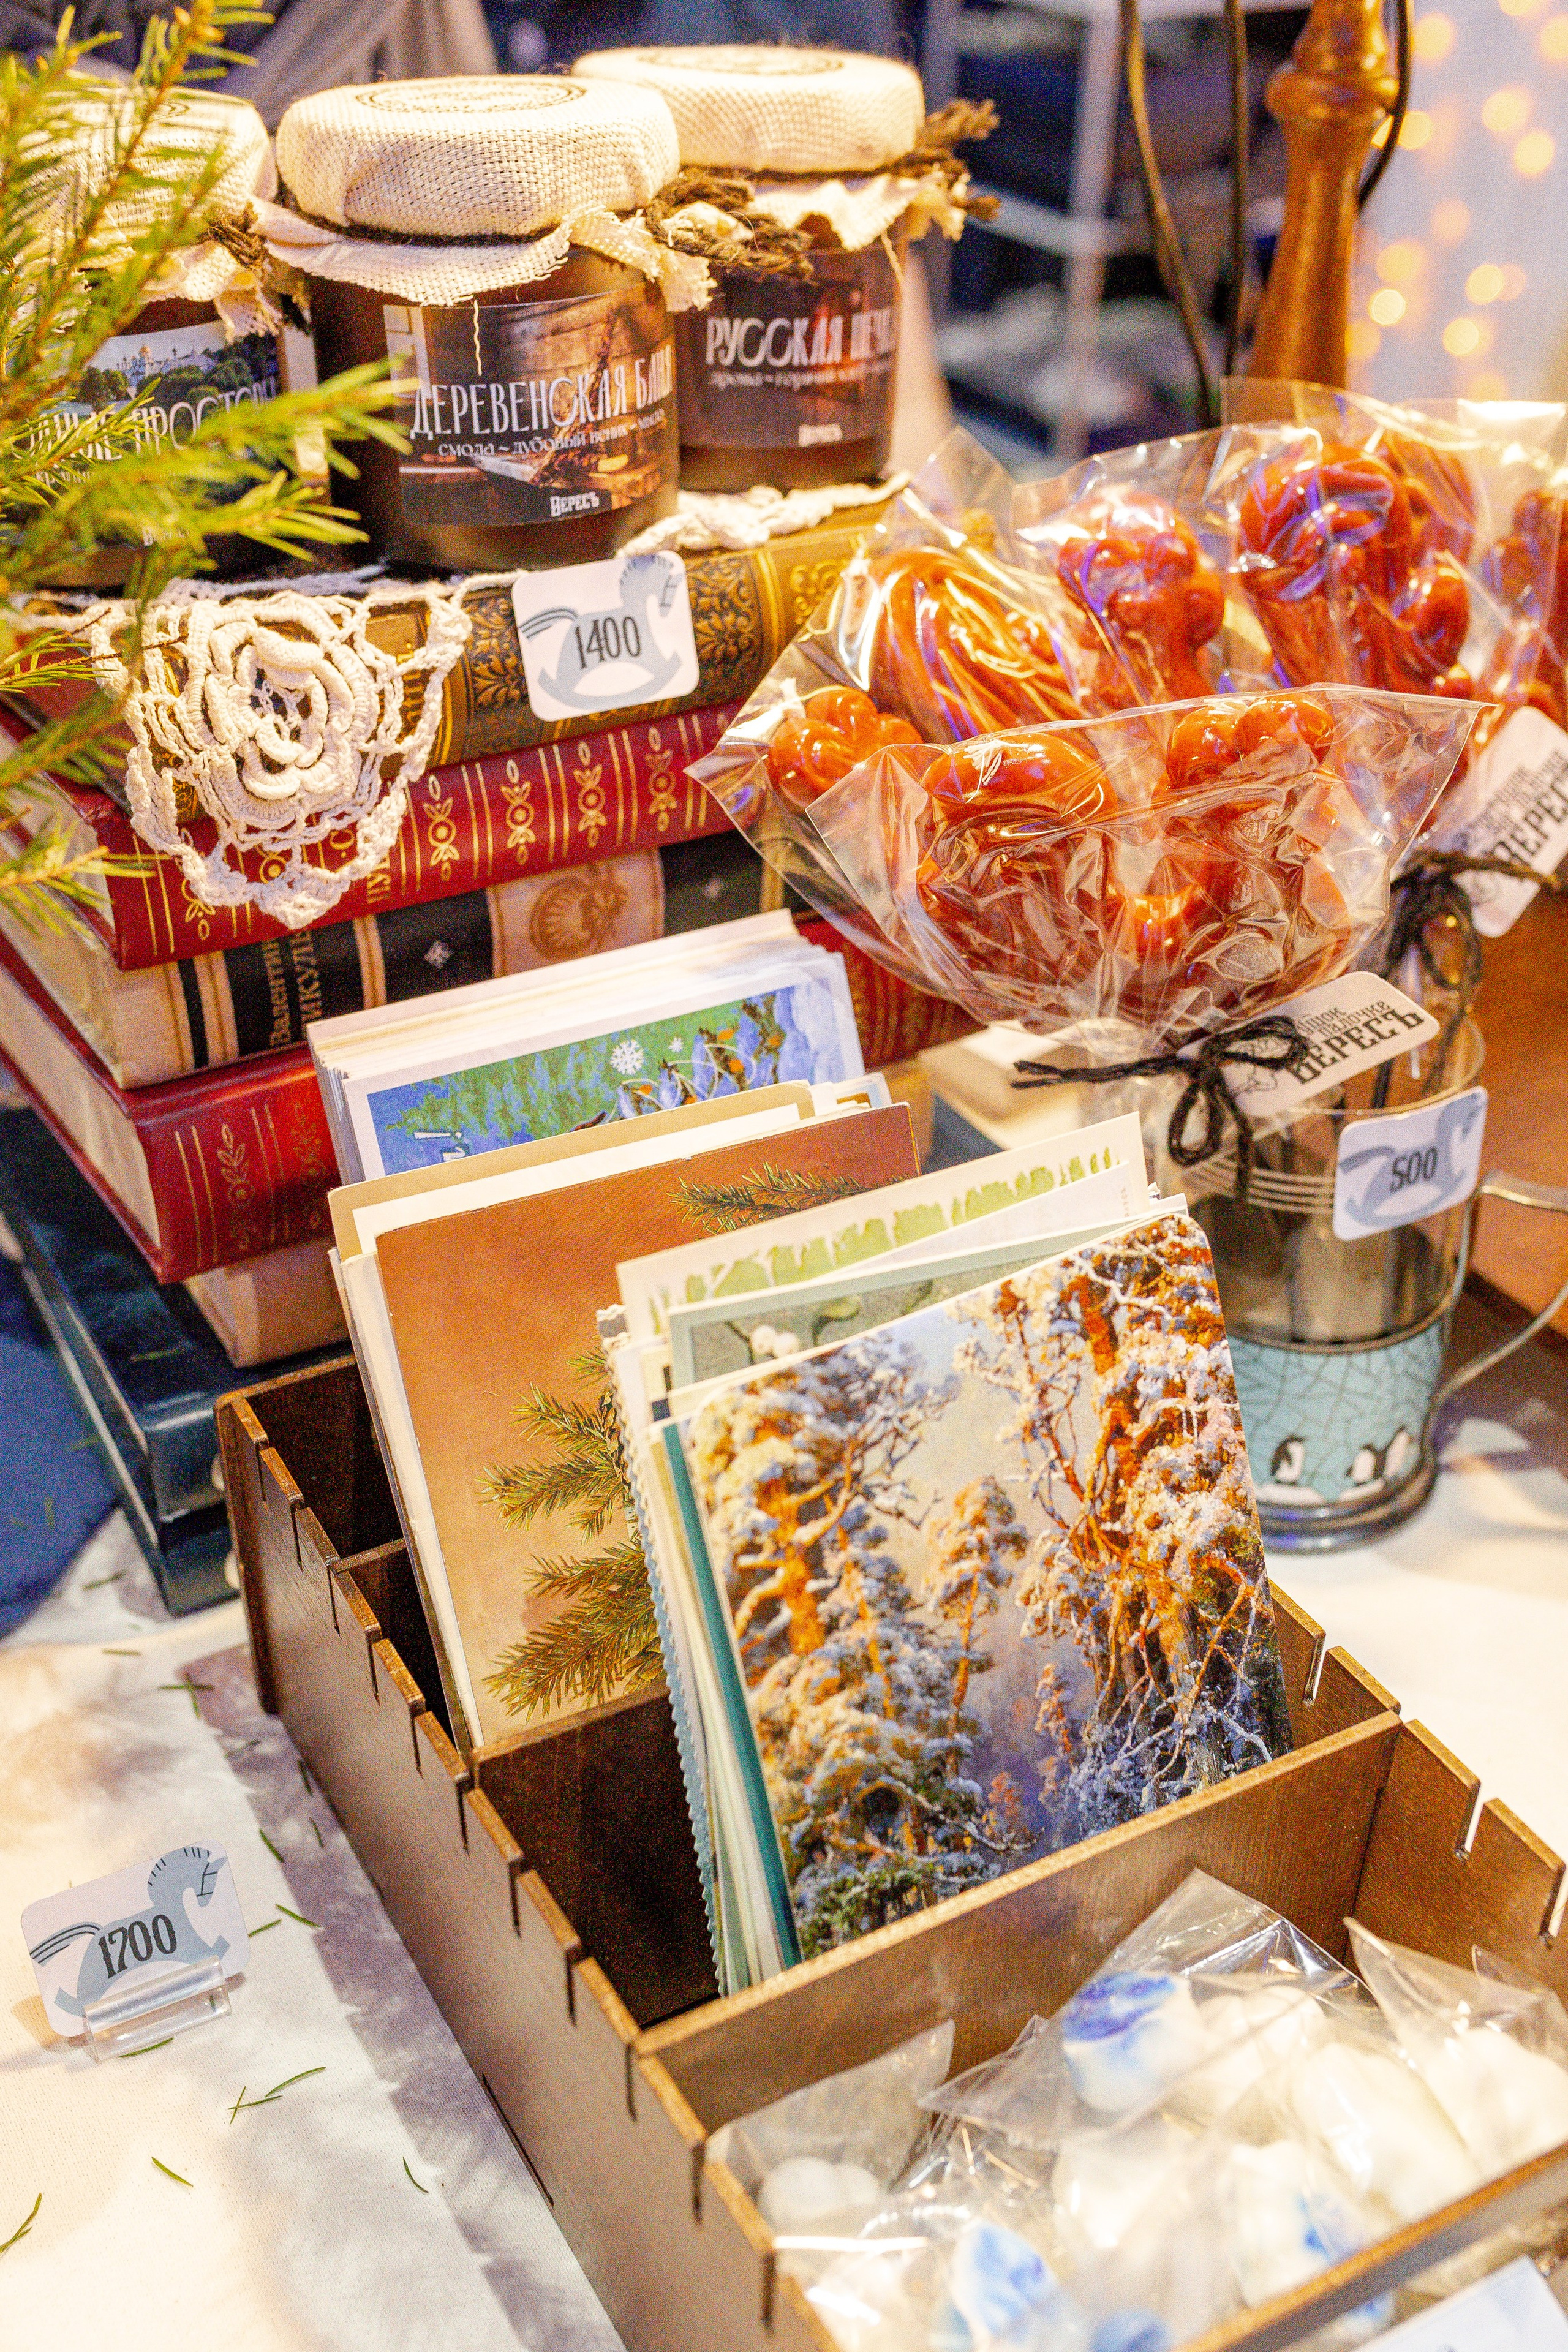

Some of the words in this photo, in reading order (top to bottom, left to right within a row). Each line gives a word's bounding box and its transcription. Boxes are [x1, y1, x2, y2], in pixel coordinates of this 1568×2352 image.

[705, 314, 843, 367] РУССКАЯ
[409, 364, 627, 441] ДЕРЕВЕНСКАЯ
[437, 437, 496, 458] смола
[575, 616, 641, 670] 1400
[290, 932, 323, 1034] ИКУЛЬ
[1389, 1147, 1439, 1194] 500
[98, 1913, 178, 1980] 1700
